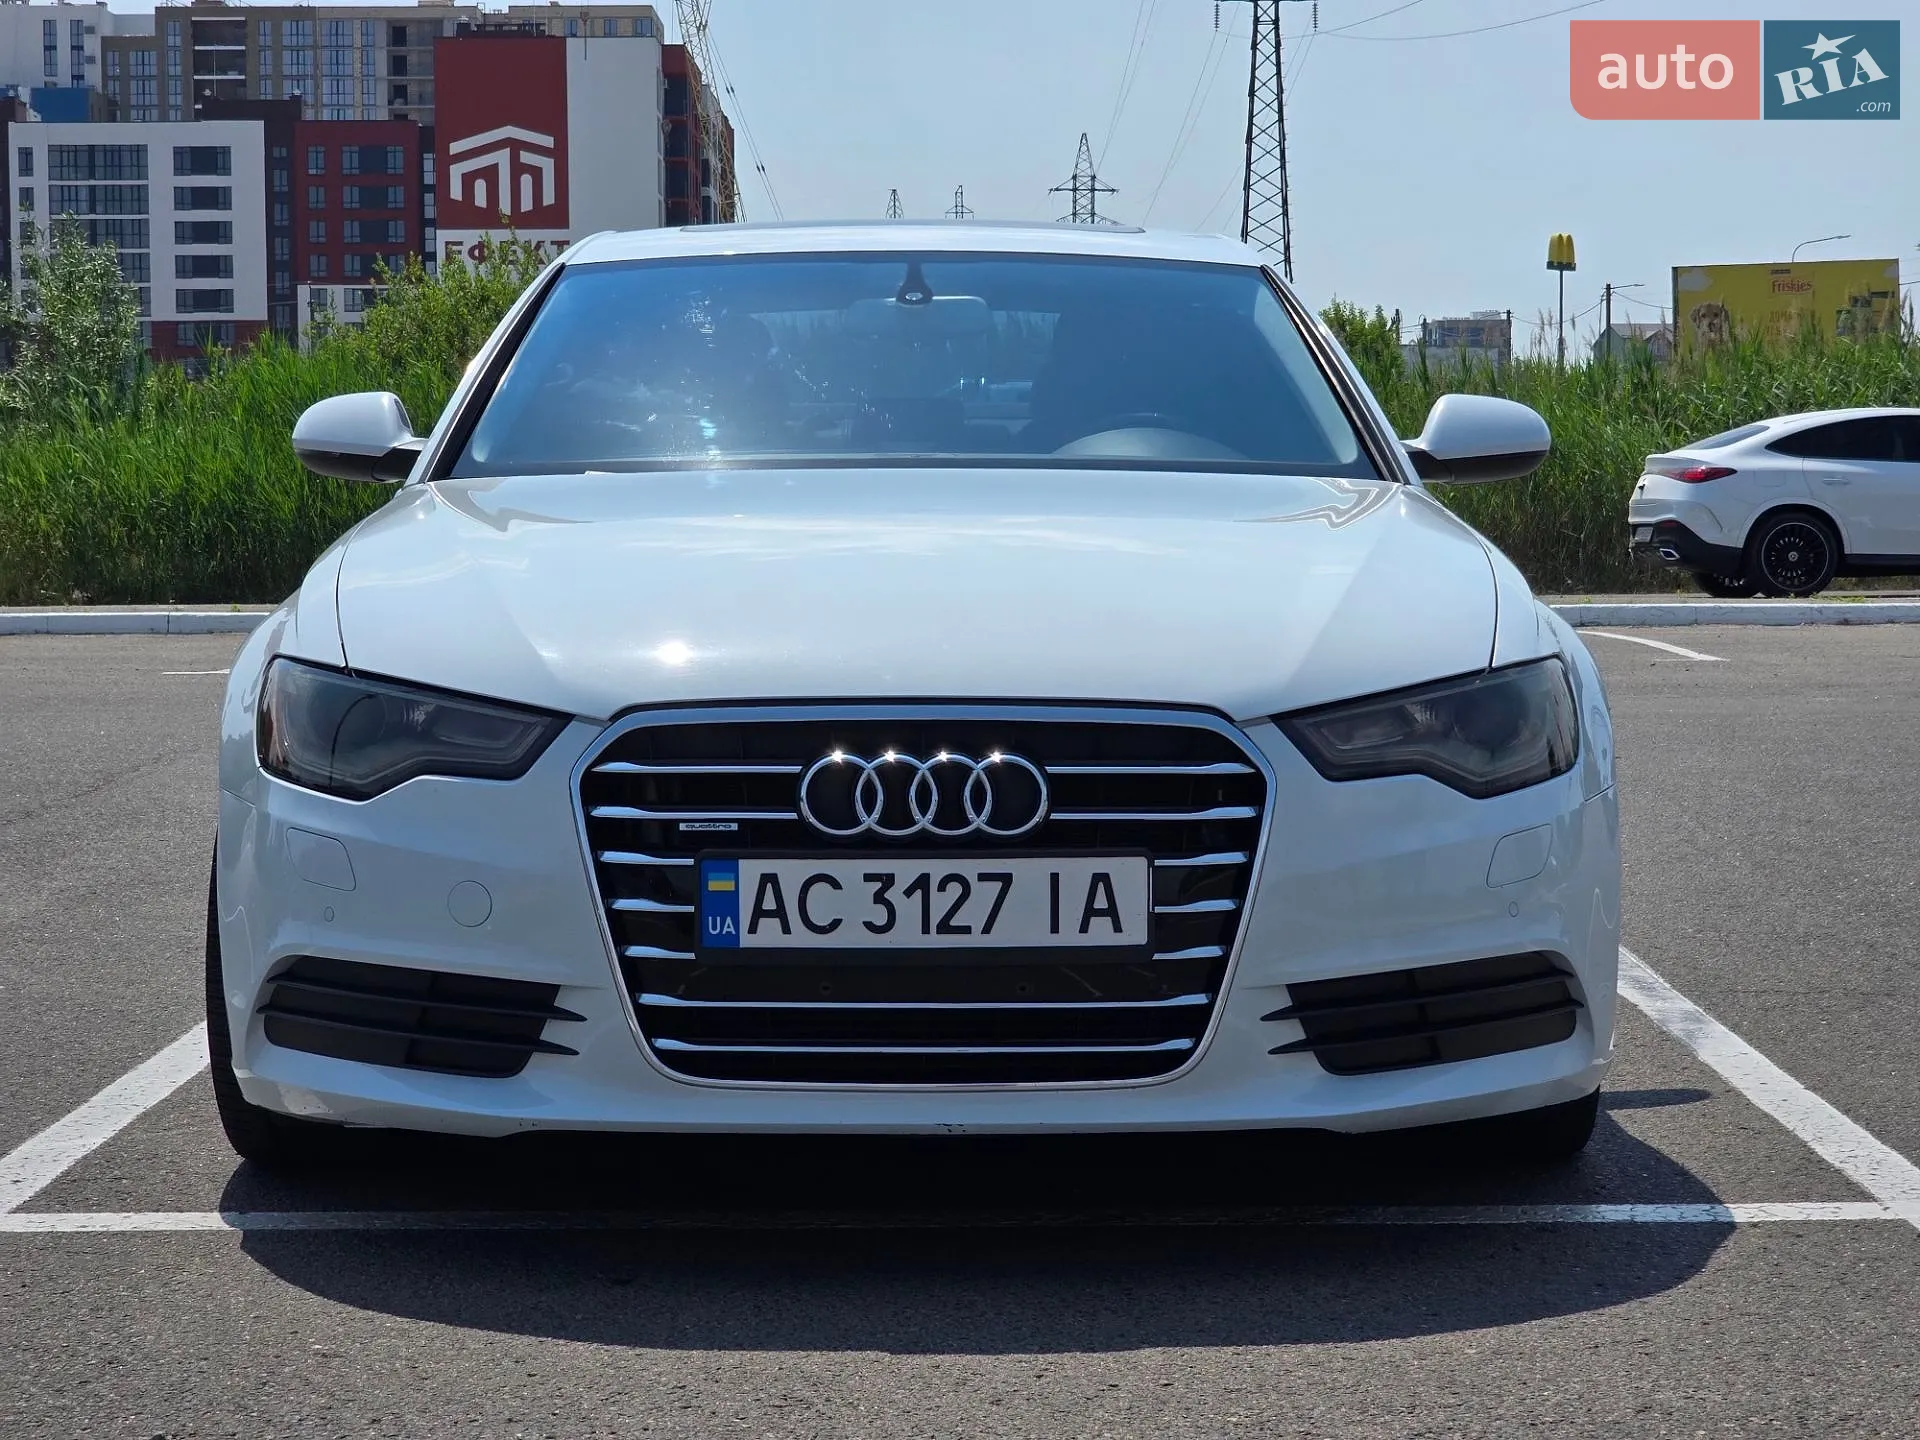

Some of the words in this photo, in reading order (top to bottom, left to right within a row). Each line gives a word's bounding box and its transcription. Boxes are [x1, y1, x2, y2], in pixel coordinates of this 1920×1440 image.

[1771, 279, 1813, 294] Friskies
[685, 823, 732, 831] quattro
[747, 872, 844, 935] AC
[862, 872, 1014, 935] 3127
[1049, 871, 1124, 934] IA
[708, 915, 737, 935] UA
